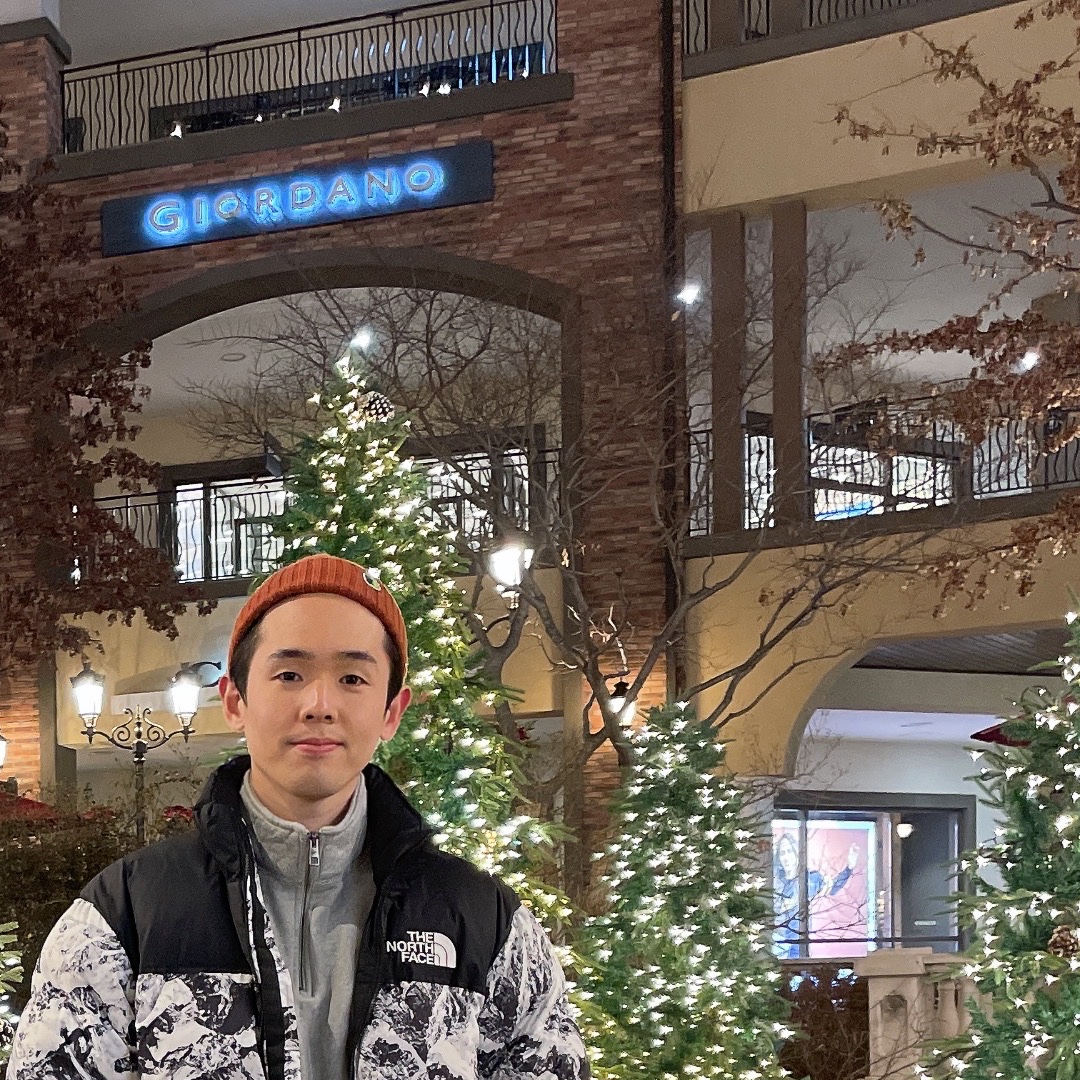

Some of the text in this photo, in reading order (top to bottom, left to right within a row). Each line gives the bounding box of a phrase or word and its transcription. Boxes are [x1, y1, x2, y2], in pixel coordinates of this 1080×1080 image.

[147, 161, 437, 234] GIORDANO
[406, 930, 434, 943] THE
[386, 940, 434, 953] NORTH
[400, 951, 435, 965] FACE
